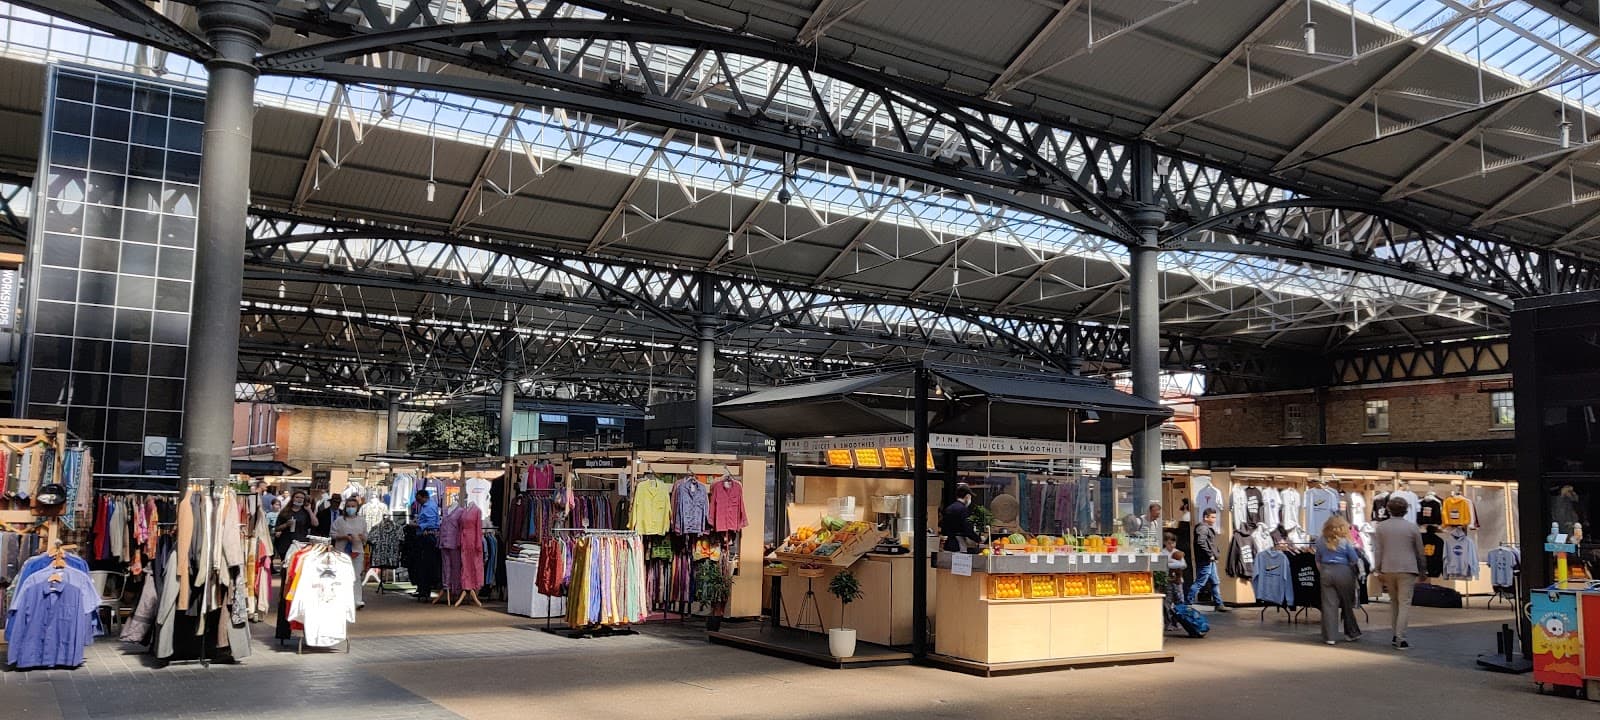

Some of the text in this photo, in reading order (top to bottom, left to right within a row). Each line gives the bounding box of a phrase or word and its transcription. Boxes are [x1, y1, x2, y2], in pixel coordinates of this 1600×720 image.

[0, 270, 14, 325] WORKSHOPS
[840, 441, 875, 449] SMOOTHIES
[1019, 445, 1063, 453] SMOOTHIES
